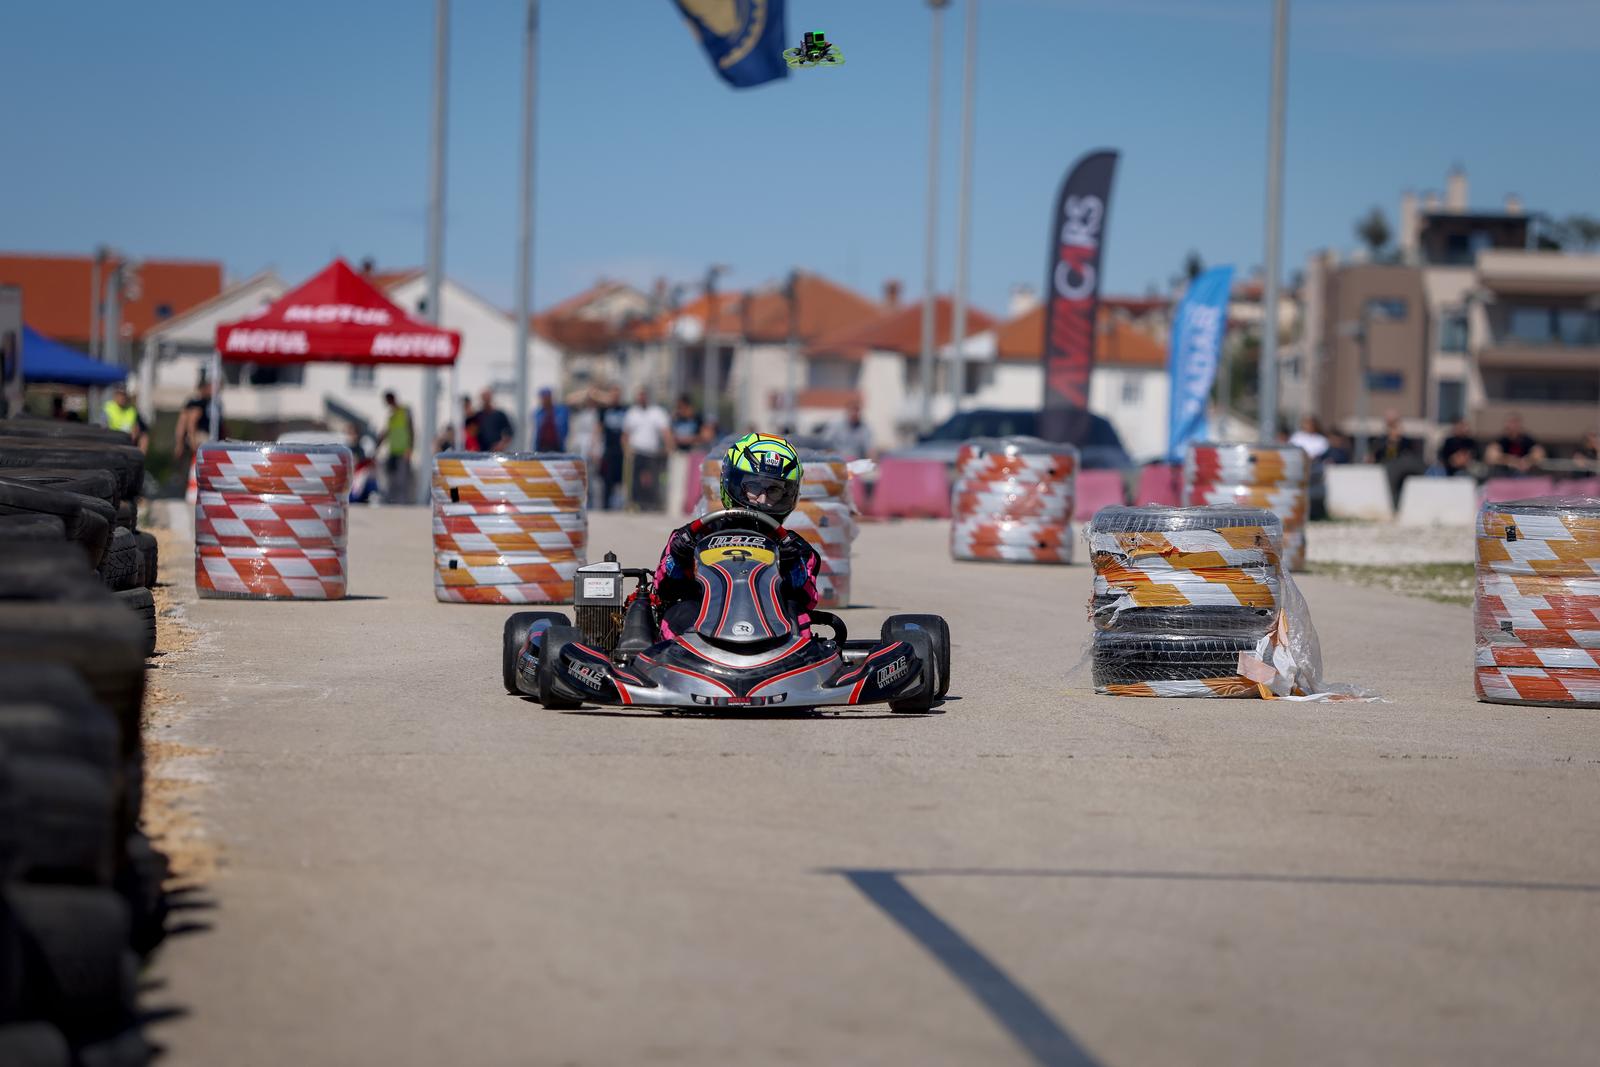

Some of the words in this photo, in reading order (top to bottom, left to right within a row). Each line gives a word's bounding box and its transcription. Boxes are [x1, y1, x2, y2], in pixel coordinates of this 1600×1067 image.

[282, 304, 391, 326] MOTUL
[226, 329, 310, 354] MOTUL
[370, 333, 453, 357] MOTUL
